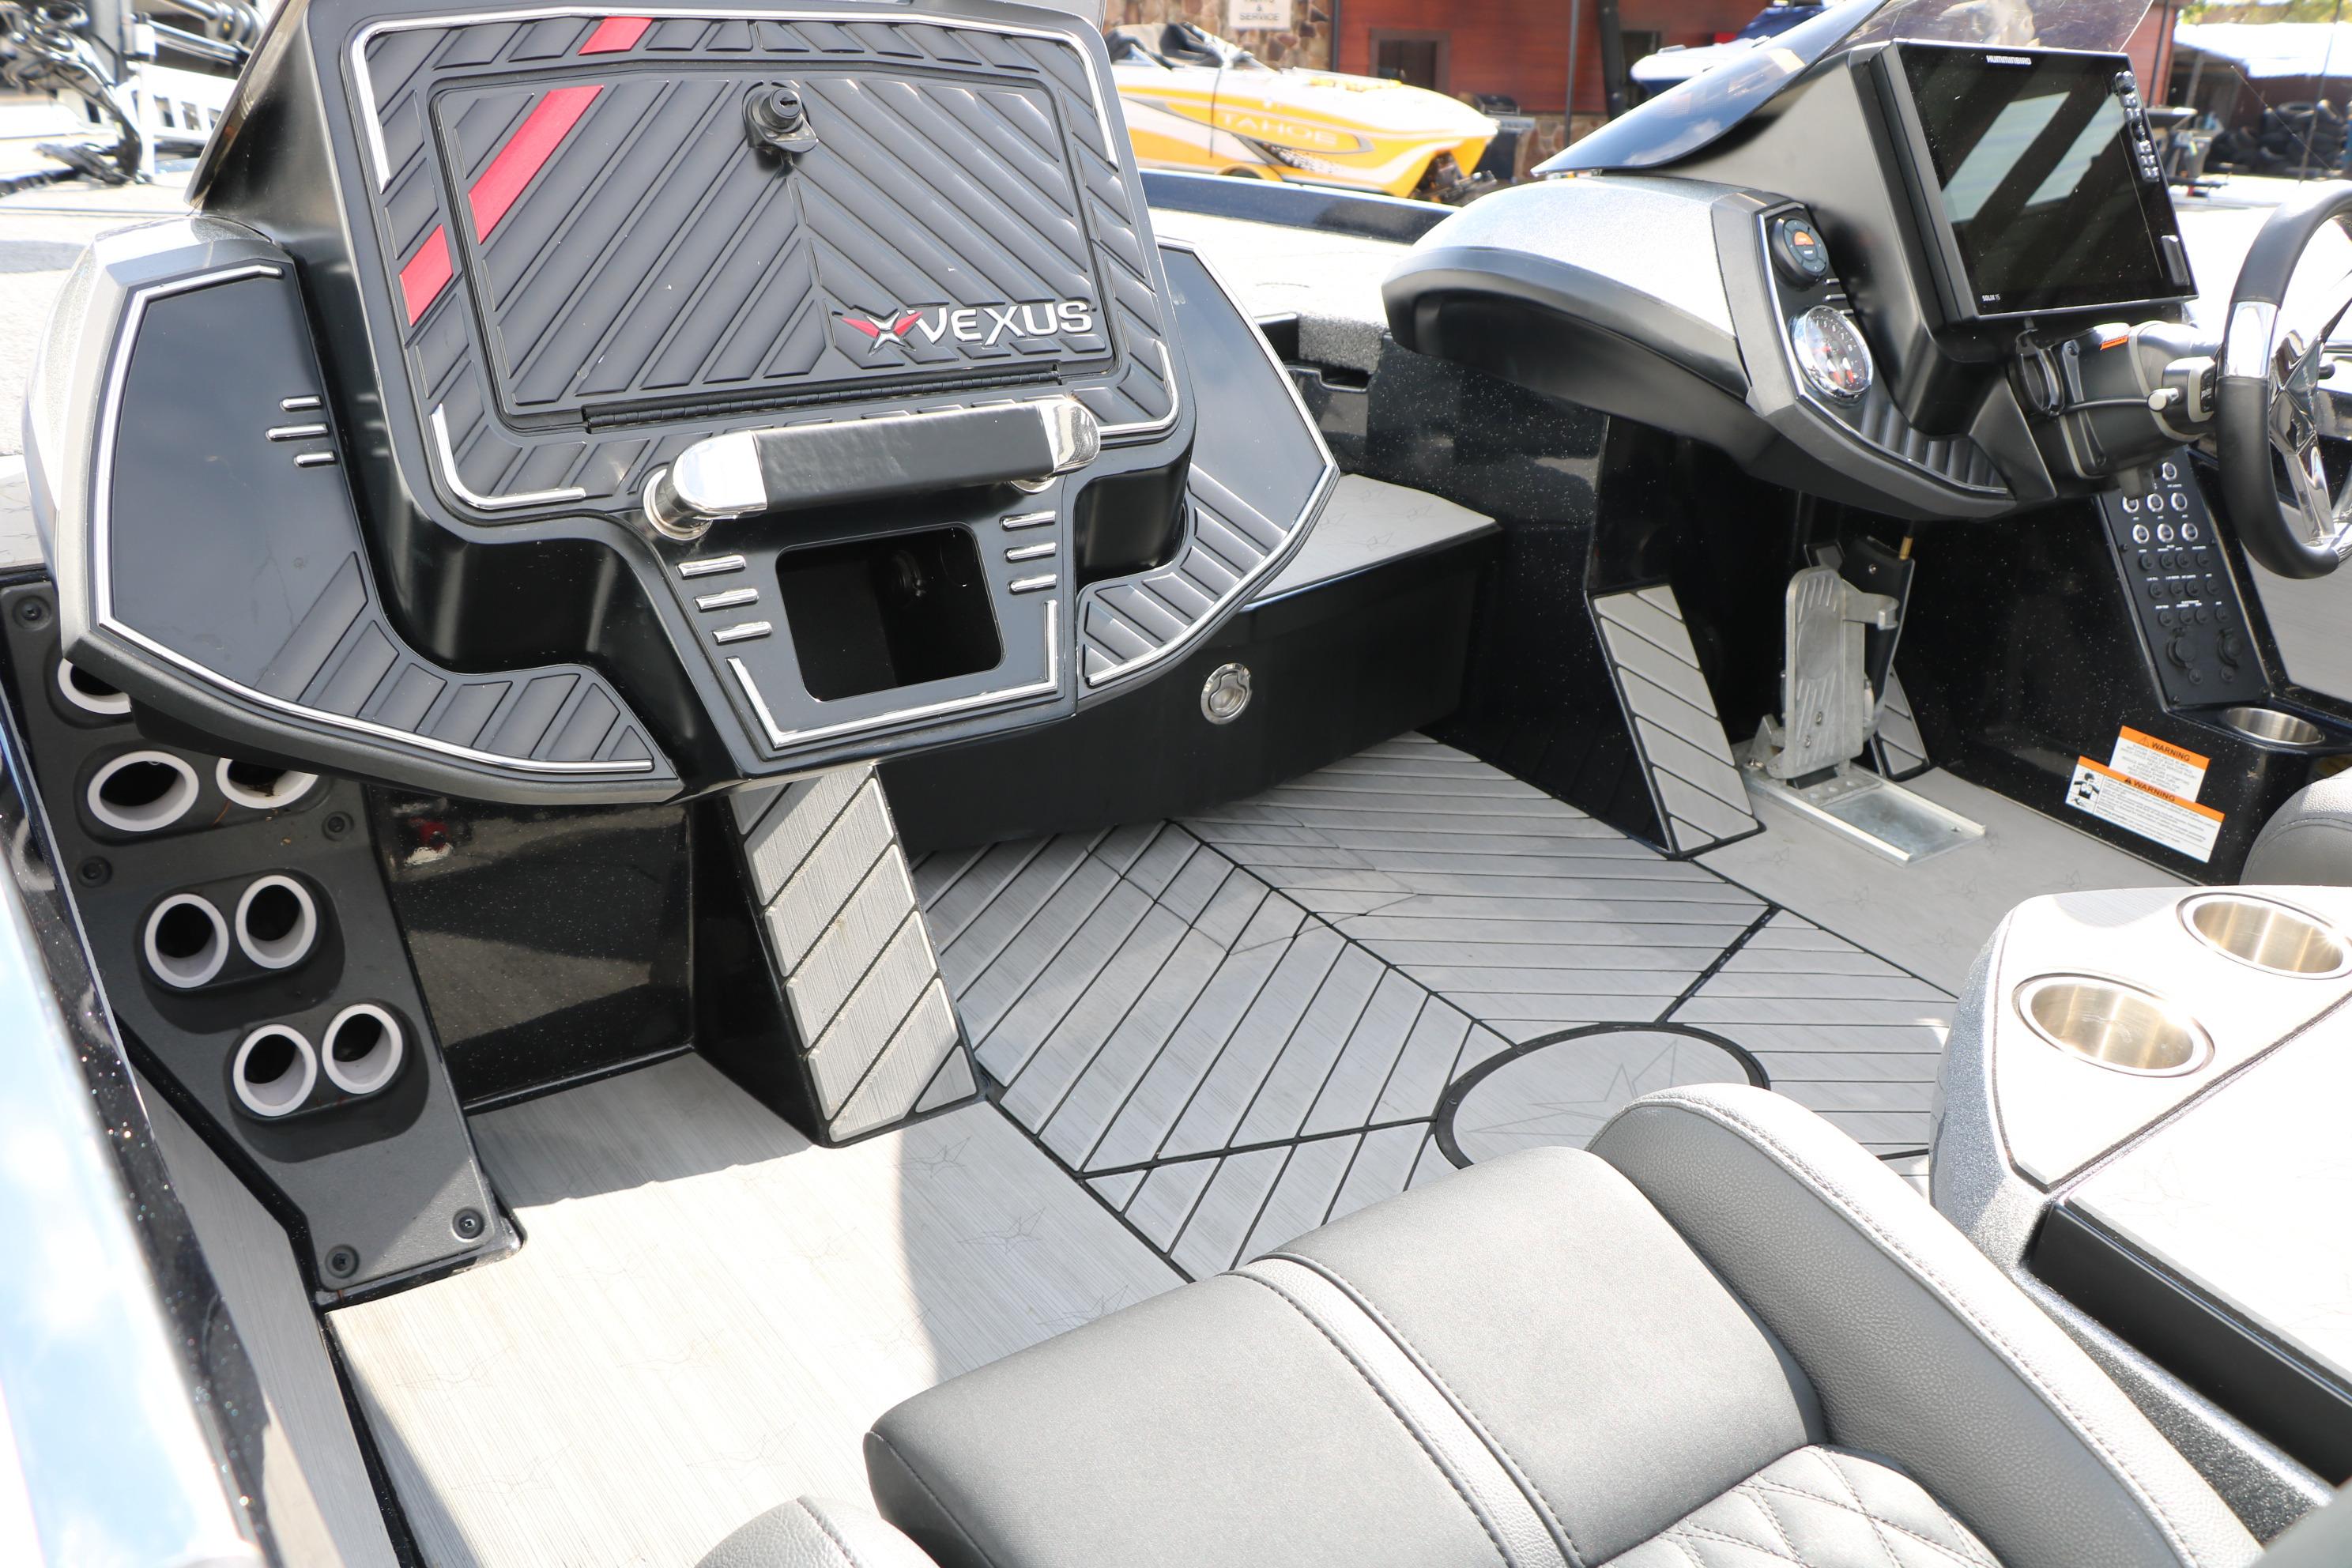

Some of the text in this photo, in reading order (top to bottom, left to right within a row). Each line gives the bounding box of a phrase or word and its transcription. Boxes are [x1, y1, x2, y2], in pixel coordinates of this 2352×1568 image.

[1238, 12, 1280, 21] SERVICE
[1986, 55, 2032, 65] HUMMINBIRD
[1219, 112, 1337, 145] TAHOE
[915, 301, 1093, 346] VEXUS
[2151, 741, 2191, 762] WARNING
[2134, 781, 2176, 801] WARNING
